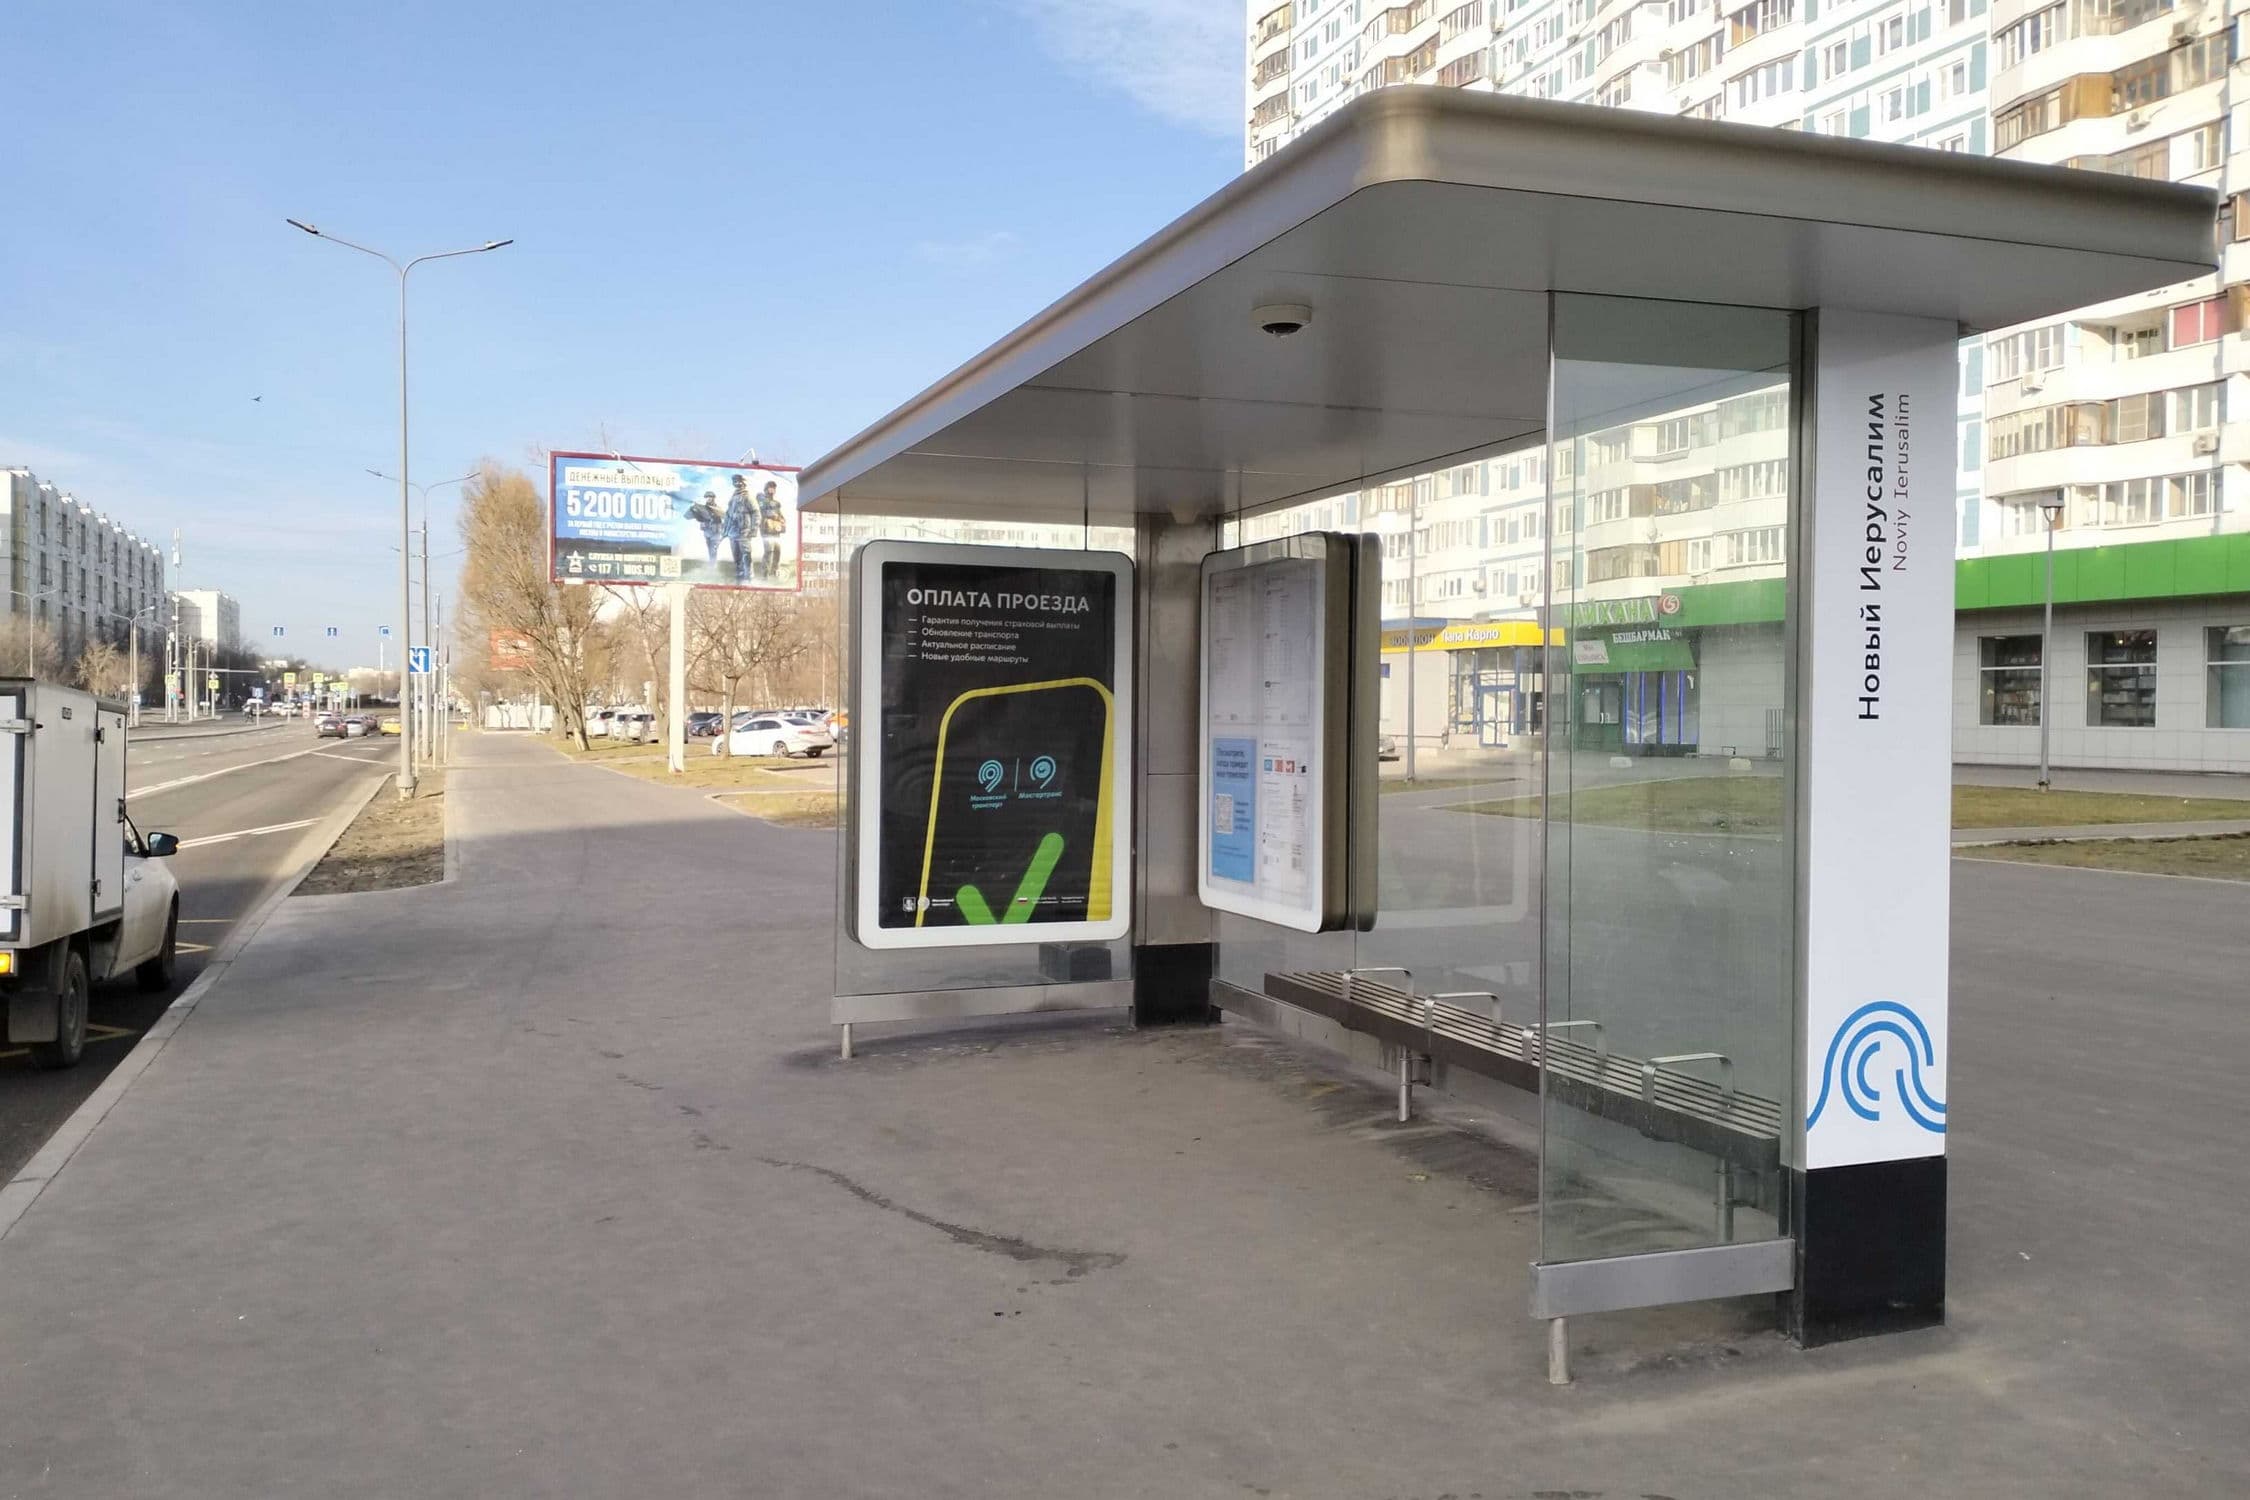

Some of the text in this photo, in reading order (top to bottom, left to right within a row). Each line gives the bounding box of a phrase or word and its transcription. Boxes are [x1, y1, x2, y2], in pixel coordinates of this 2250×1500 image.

[569, 471, 618, 484] ДЕНЕЖНЫЕ
[621, 474, 664, 487] ВЫПЛАТЫ
[1892, 393, 1911, 571] Noviy Ierusalim
[567, 489, 581, 517] 5
[583, 491, 627, 519] 200
[1858, 392, 1887, 720] Новый Иерусалим
[906, 588, 1090, 614] ОПЛАТА ПРОЕЗДА
[921, 615, 1081, 630] Гарантия получения страховой выплаты
[921, 628, 1020, 640] Обновление транспорта
[1612, 629, 1671, 644] БЕШБАРМАК
[921, 640, 1017, 652] Актуальное расписание
[921, 652, 1029, 664] Новые удобные маршруты
